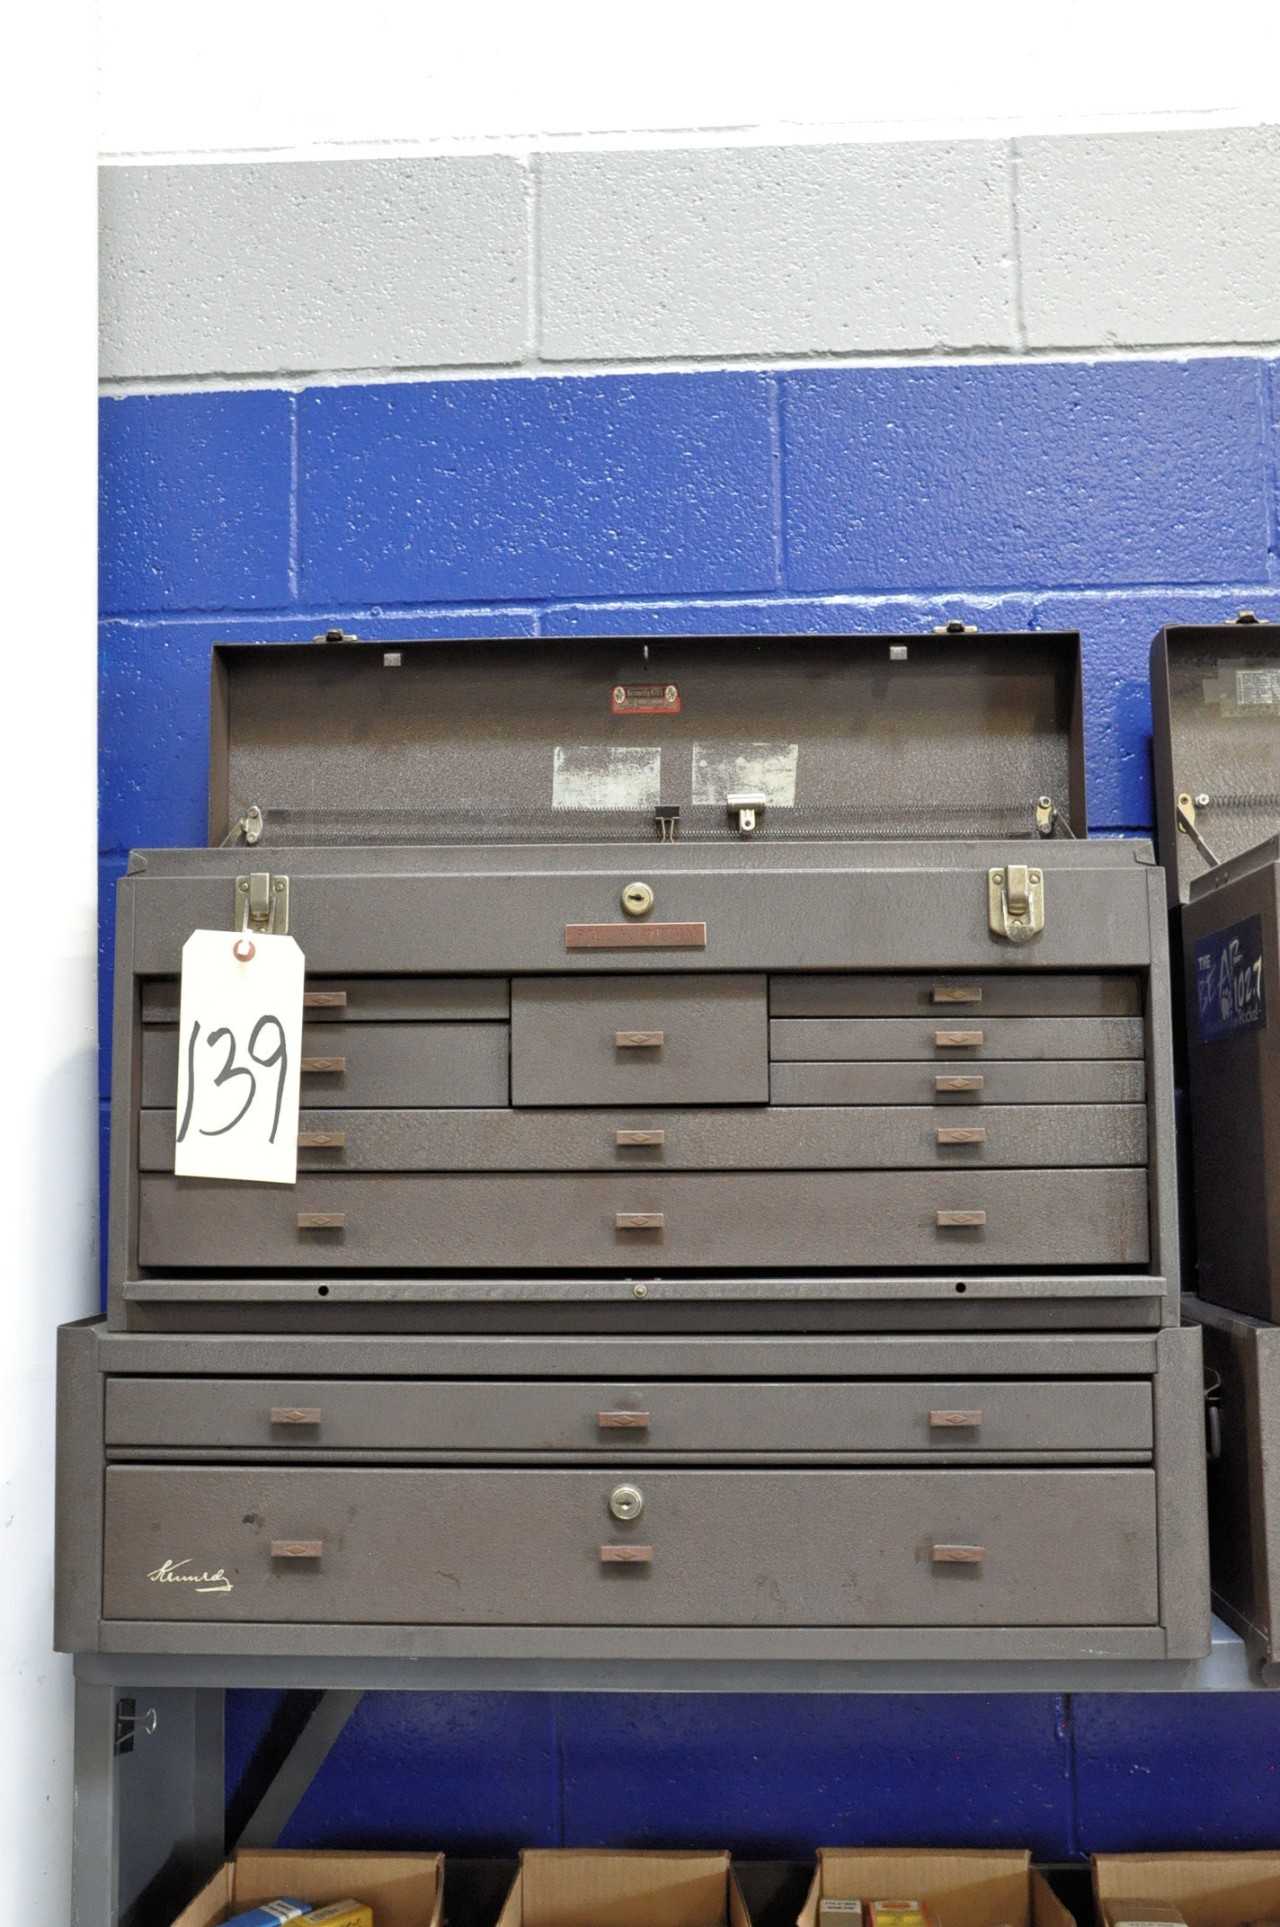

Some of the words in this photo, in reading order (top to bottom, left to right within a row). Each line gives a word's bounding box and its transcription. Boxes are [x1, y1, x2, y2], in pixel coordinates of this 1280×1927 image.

[1233, 955, 1262, 1012] 102.7
[176, 1014, 288, 1144] 139
[146, 1558, 233, 1592] Kennedy
